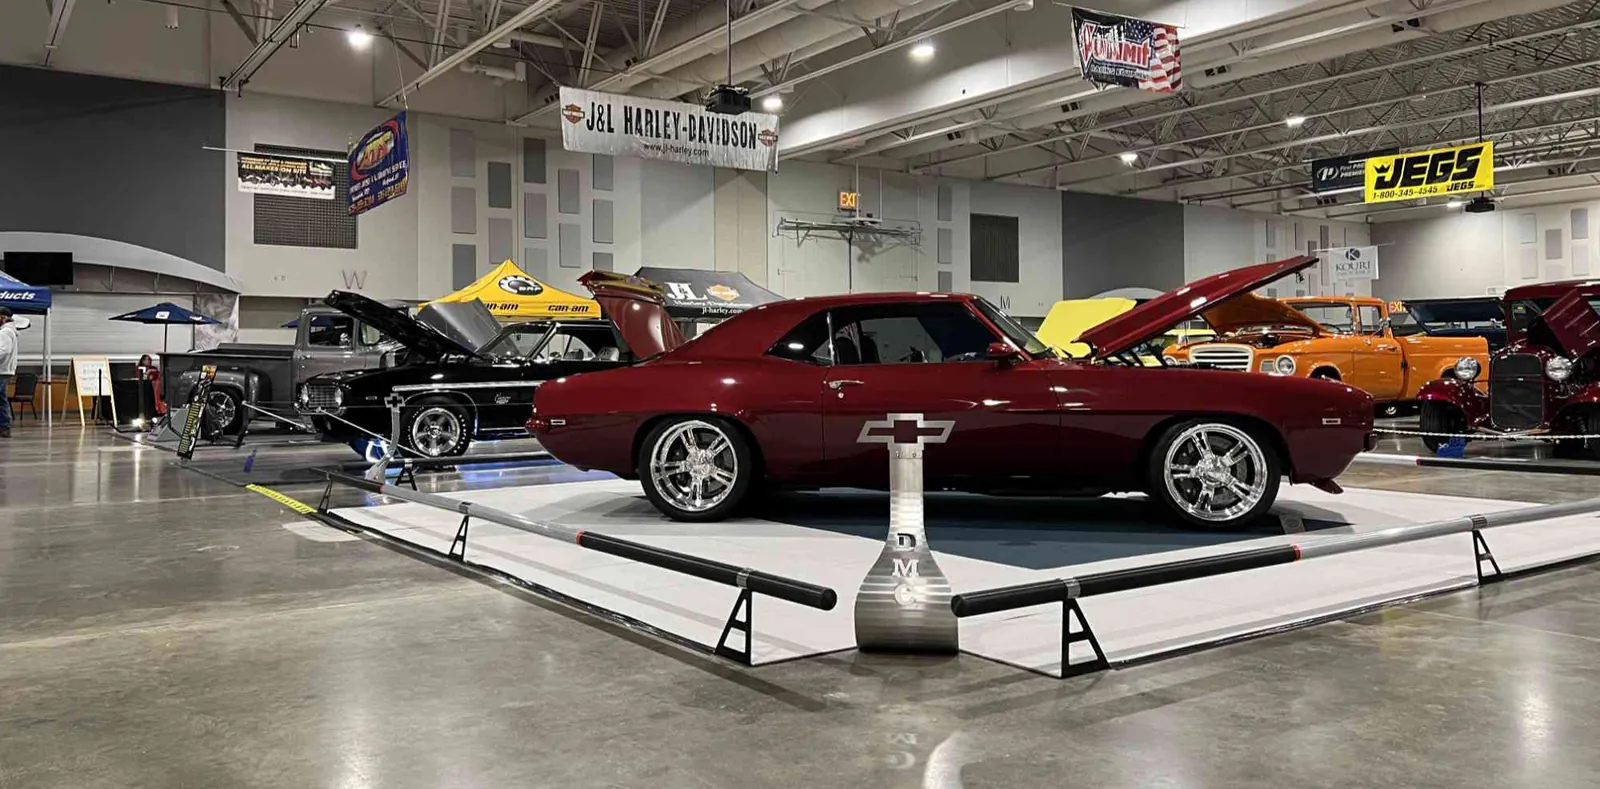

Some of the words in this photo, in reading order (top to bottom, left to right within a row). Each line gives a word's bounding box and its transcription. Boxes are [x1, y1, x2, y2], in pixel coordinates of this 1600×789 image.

[586, 101, 615, 134] J&L
[624, 105, 757, 150] HARLEY-DAVIDSON
[644, 143, 710, 157] www.jl-harley.com
[1374, 146, 1485, 191] JEGS
[1372, 186, 1438, 200] 1-800-345-4545
[1335, 261, 1371, 272] KOURI
[341, 269, 368, 290] W
[547, 304, 589, 313] can-am
